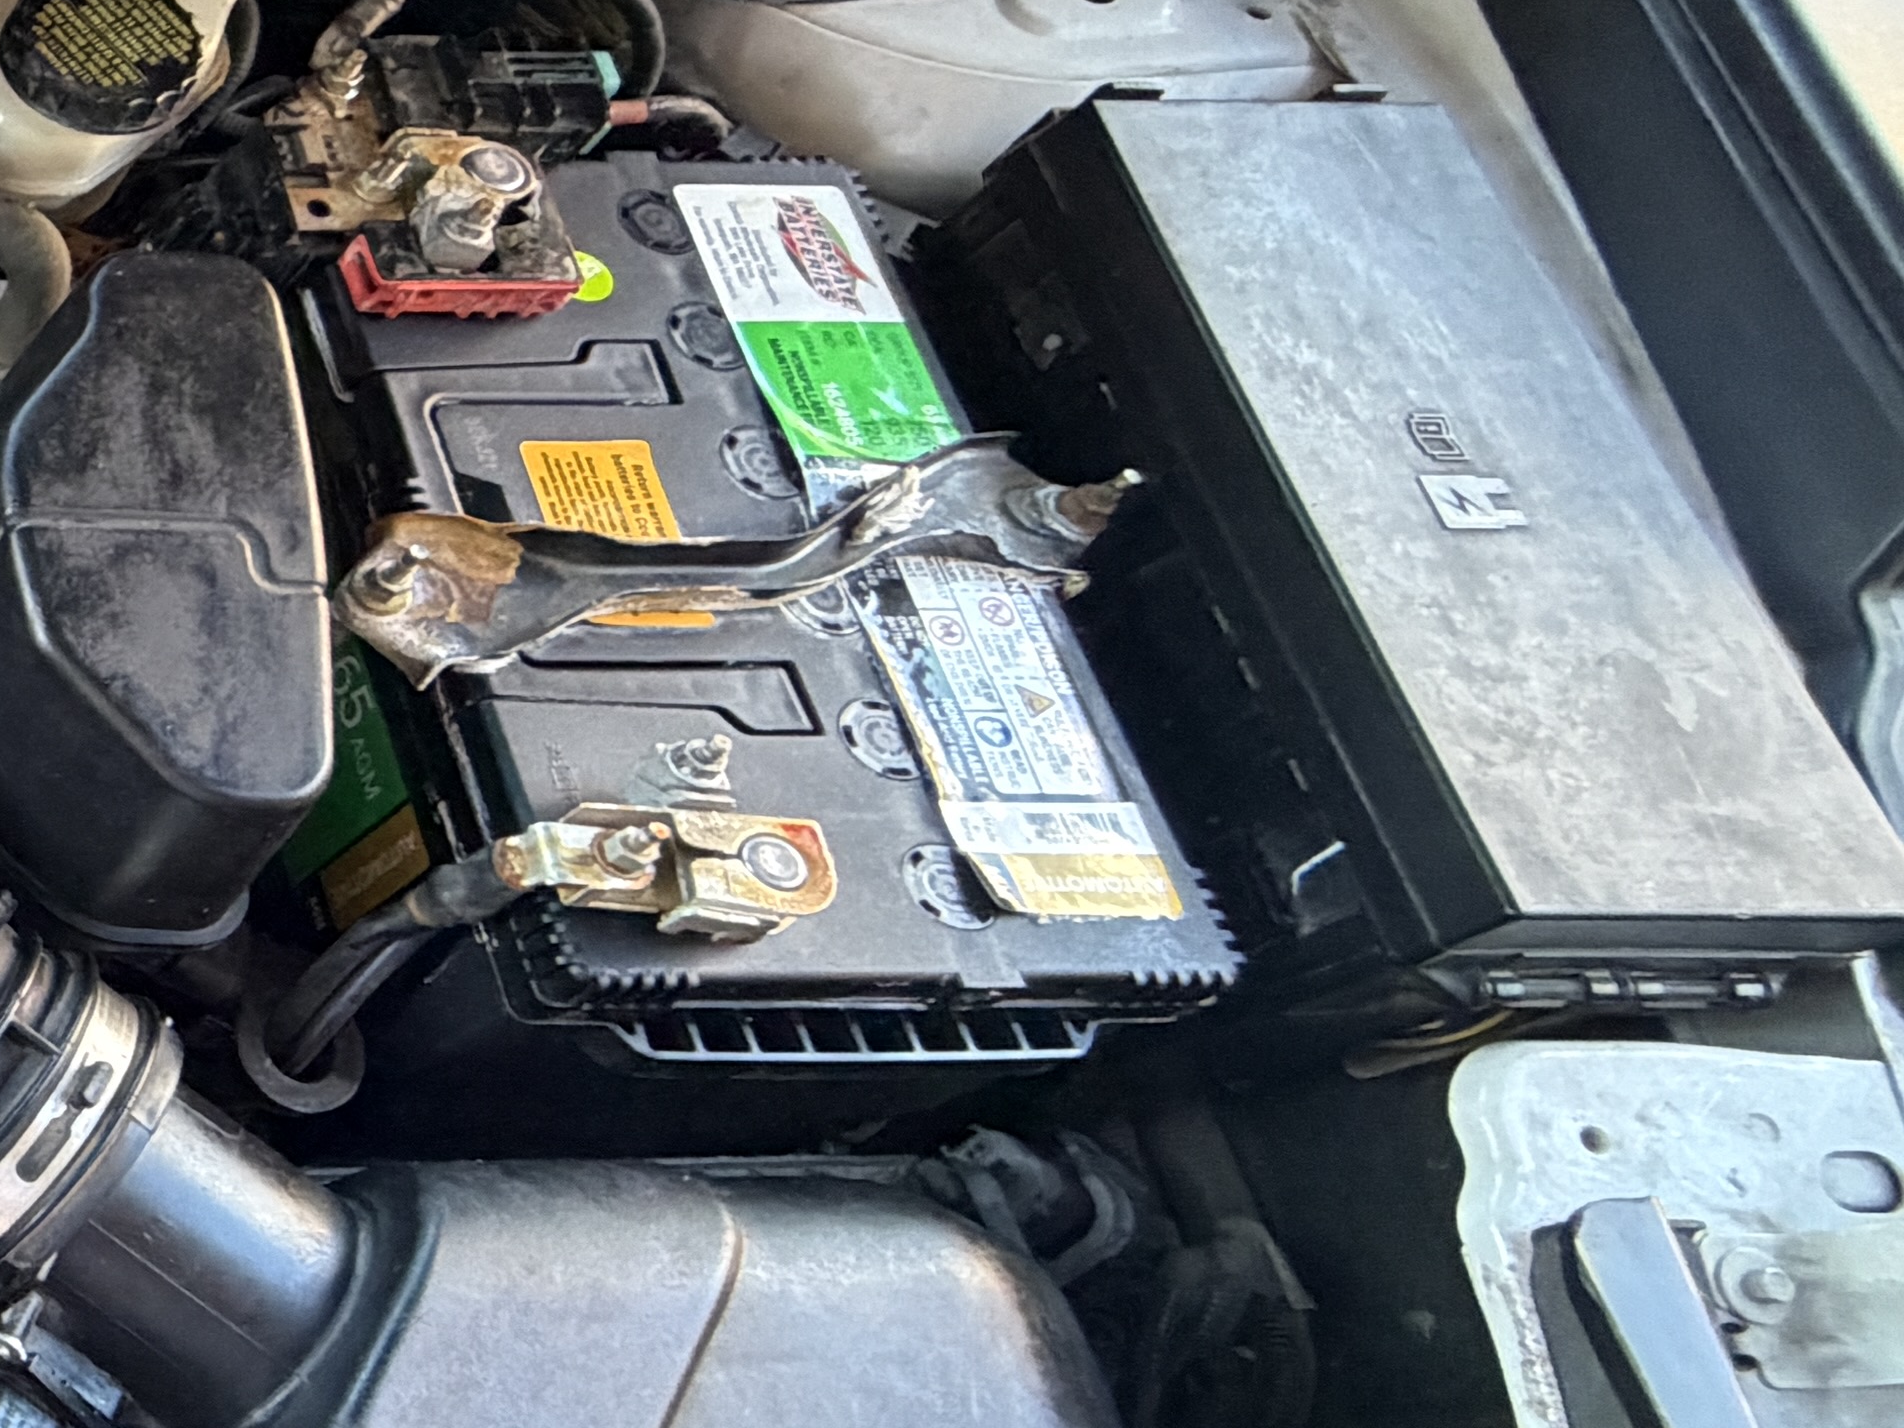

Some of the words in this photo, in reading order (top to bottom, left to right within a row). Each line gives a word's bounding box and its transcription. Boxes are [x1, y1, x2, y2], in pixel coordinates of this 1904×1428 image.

[778, 201, 837, 300] BATTERIES
[796, 198, 858, 307] INTERSTATE
[822, 382, 861, 447] 1624805
[610, 453, 637, 501] batteries
[334, 654, 373, 730] 65
[352, 737, 382, 800] AGM
[1030, 877, 1161, 894] AUTOMOTIVE
